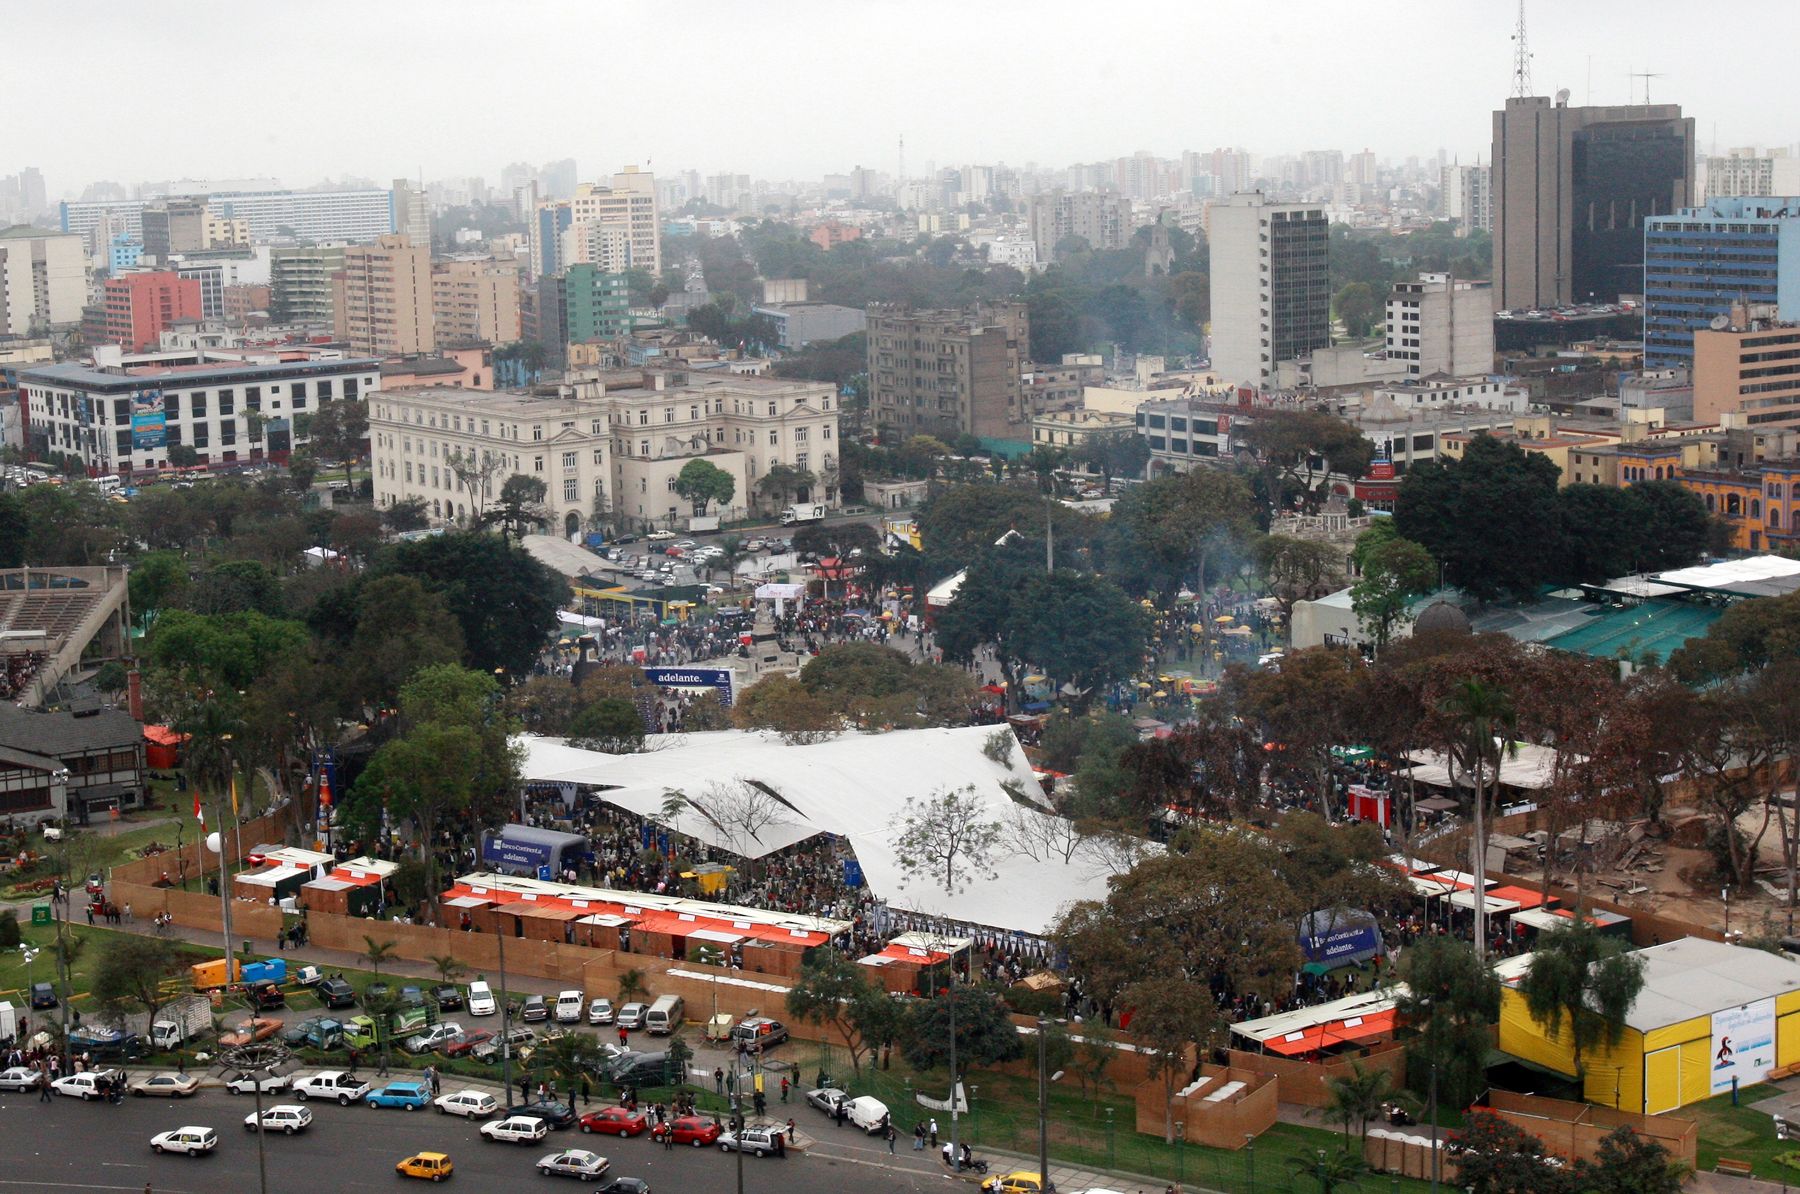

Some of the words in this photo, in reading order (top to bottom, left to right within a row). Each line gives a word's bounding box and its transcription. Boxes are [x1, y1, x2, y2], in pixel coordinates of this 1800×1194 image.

[658, 673, 703, 682] adelante.
[503, 853, 529, 862] adelante.
[1319, 936, 1336, 944] Bco
[1326, 943, 1355, 955] adelante.
